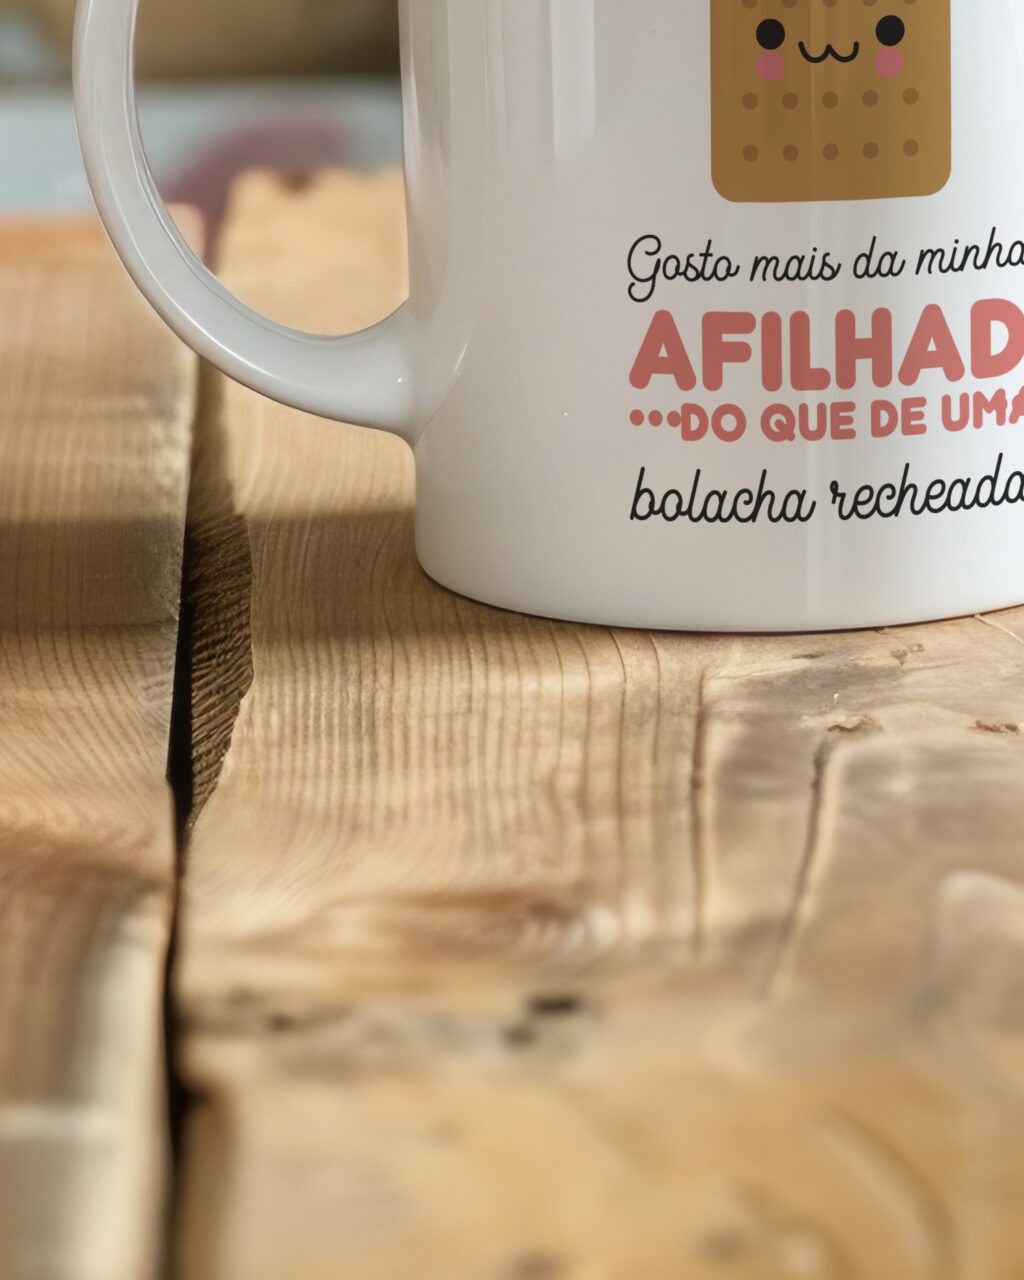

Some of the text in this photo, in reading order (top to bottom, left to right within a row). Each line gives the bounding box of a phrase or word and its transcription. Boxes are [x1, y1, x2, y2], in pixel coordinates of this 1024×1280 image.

[626, 234, 740, 303] Gosto
[749, 246, 842, 282] mais
[852, 235, 906, 280] da
[759, 401, 857, 443] QUE
[870, 396, 928, 439] DE
[629, 466, 817, 524] bolacha
